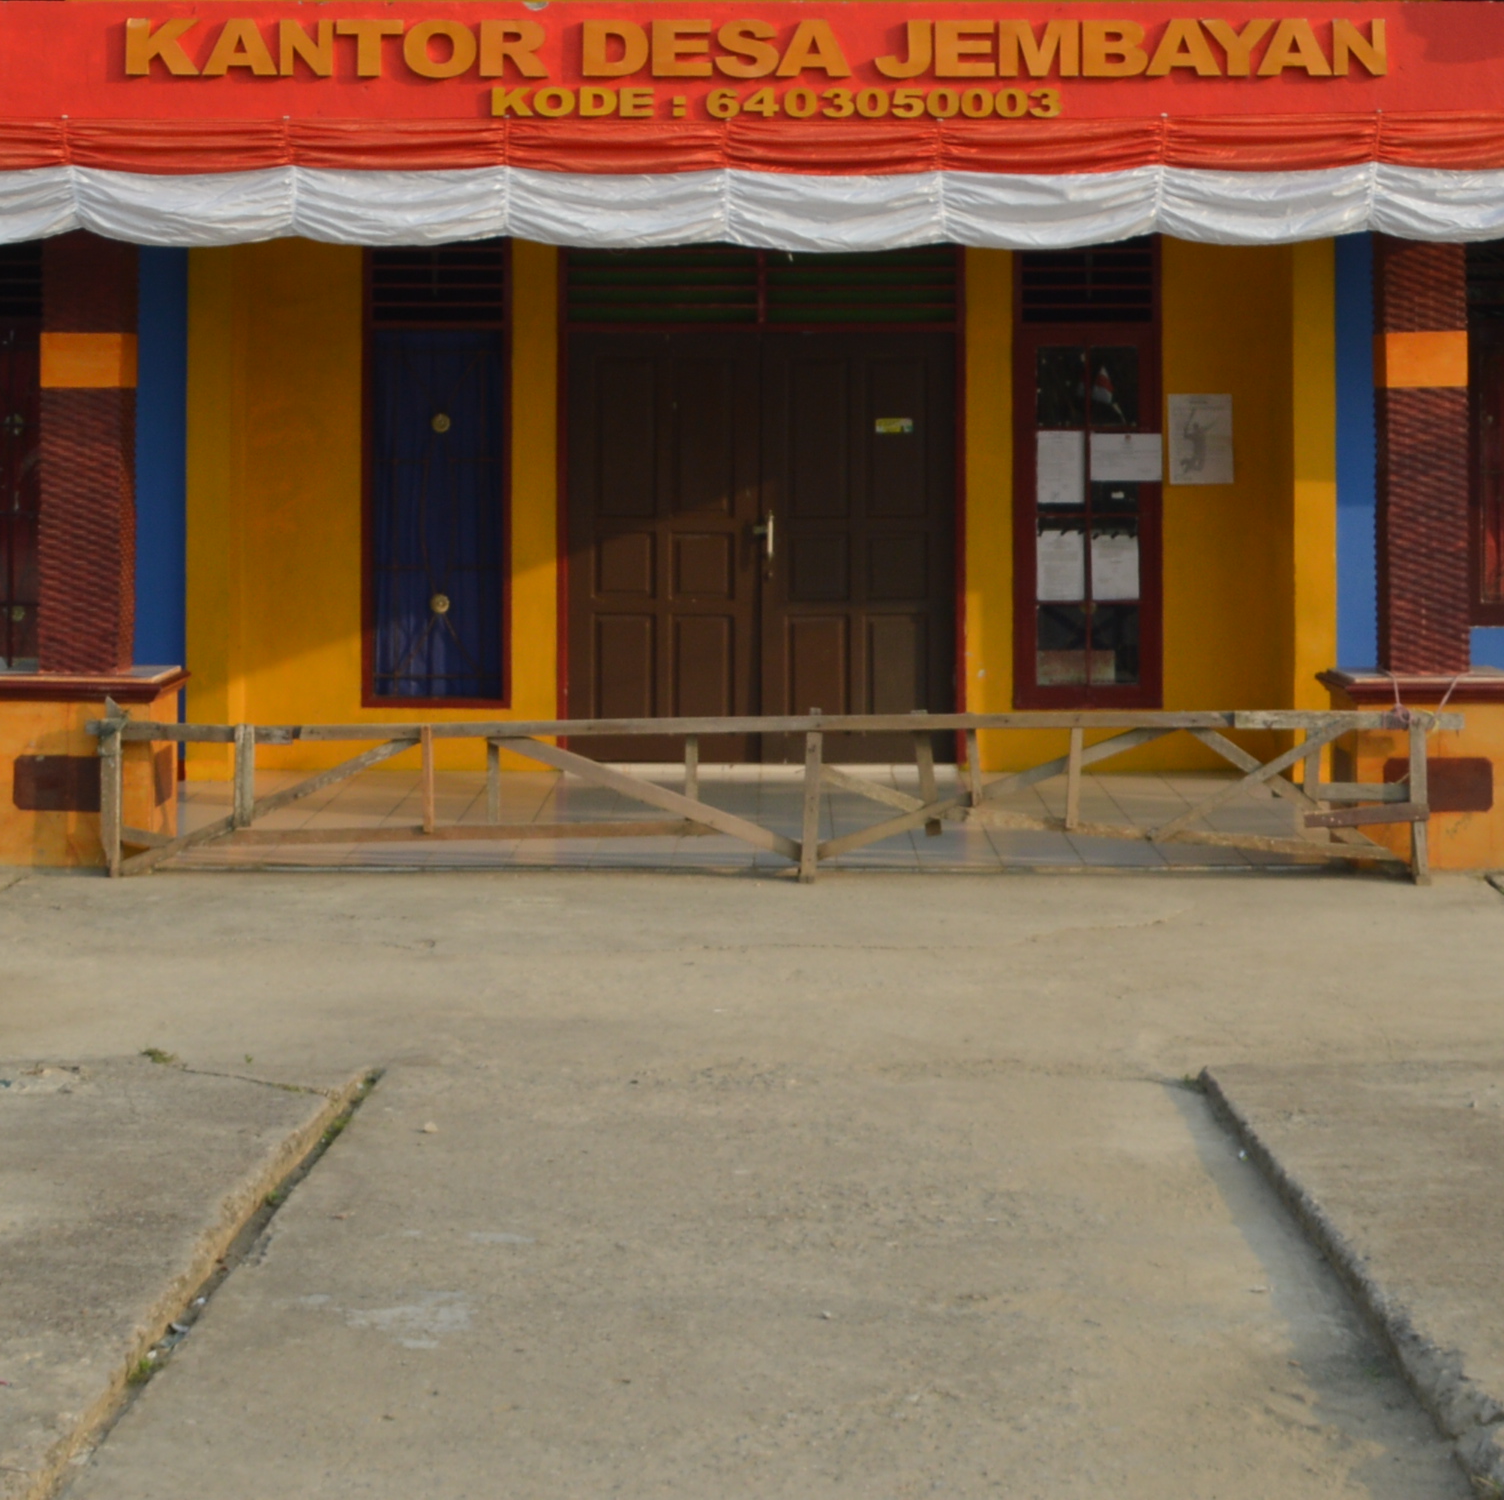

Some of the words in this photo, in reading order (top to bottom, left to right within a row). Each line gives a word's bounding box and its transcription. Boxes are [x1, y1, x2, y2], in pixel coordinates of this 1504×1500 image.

[125, 18, 549, 78] KANTOR
[582, 18, 852, 78] DESA
[874, 18, 1388, 78] JEMBAYAN
[491, 86, 654, 117] KODE
[706, 86, 1063, 118] 6403050003
